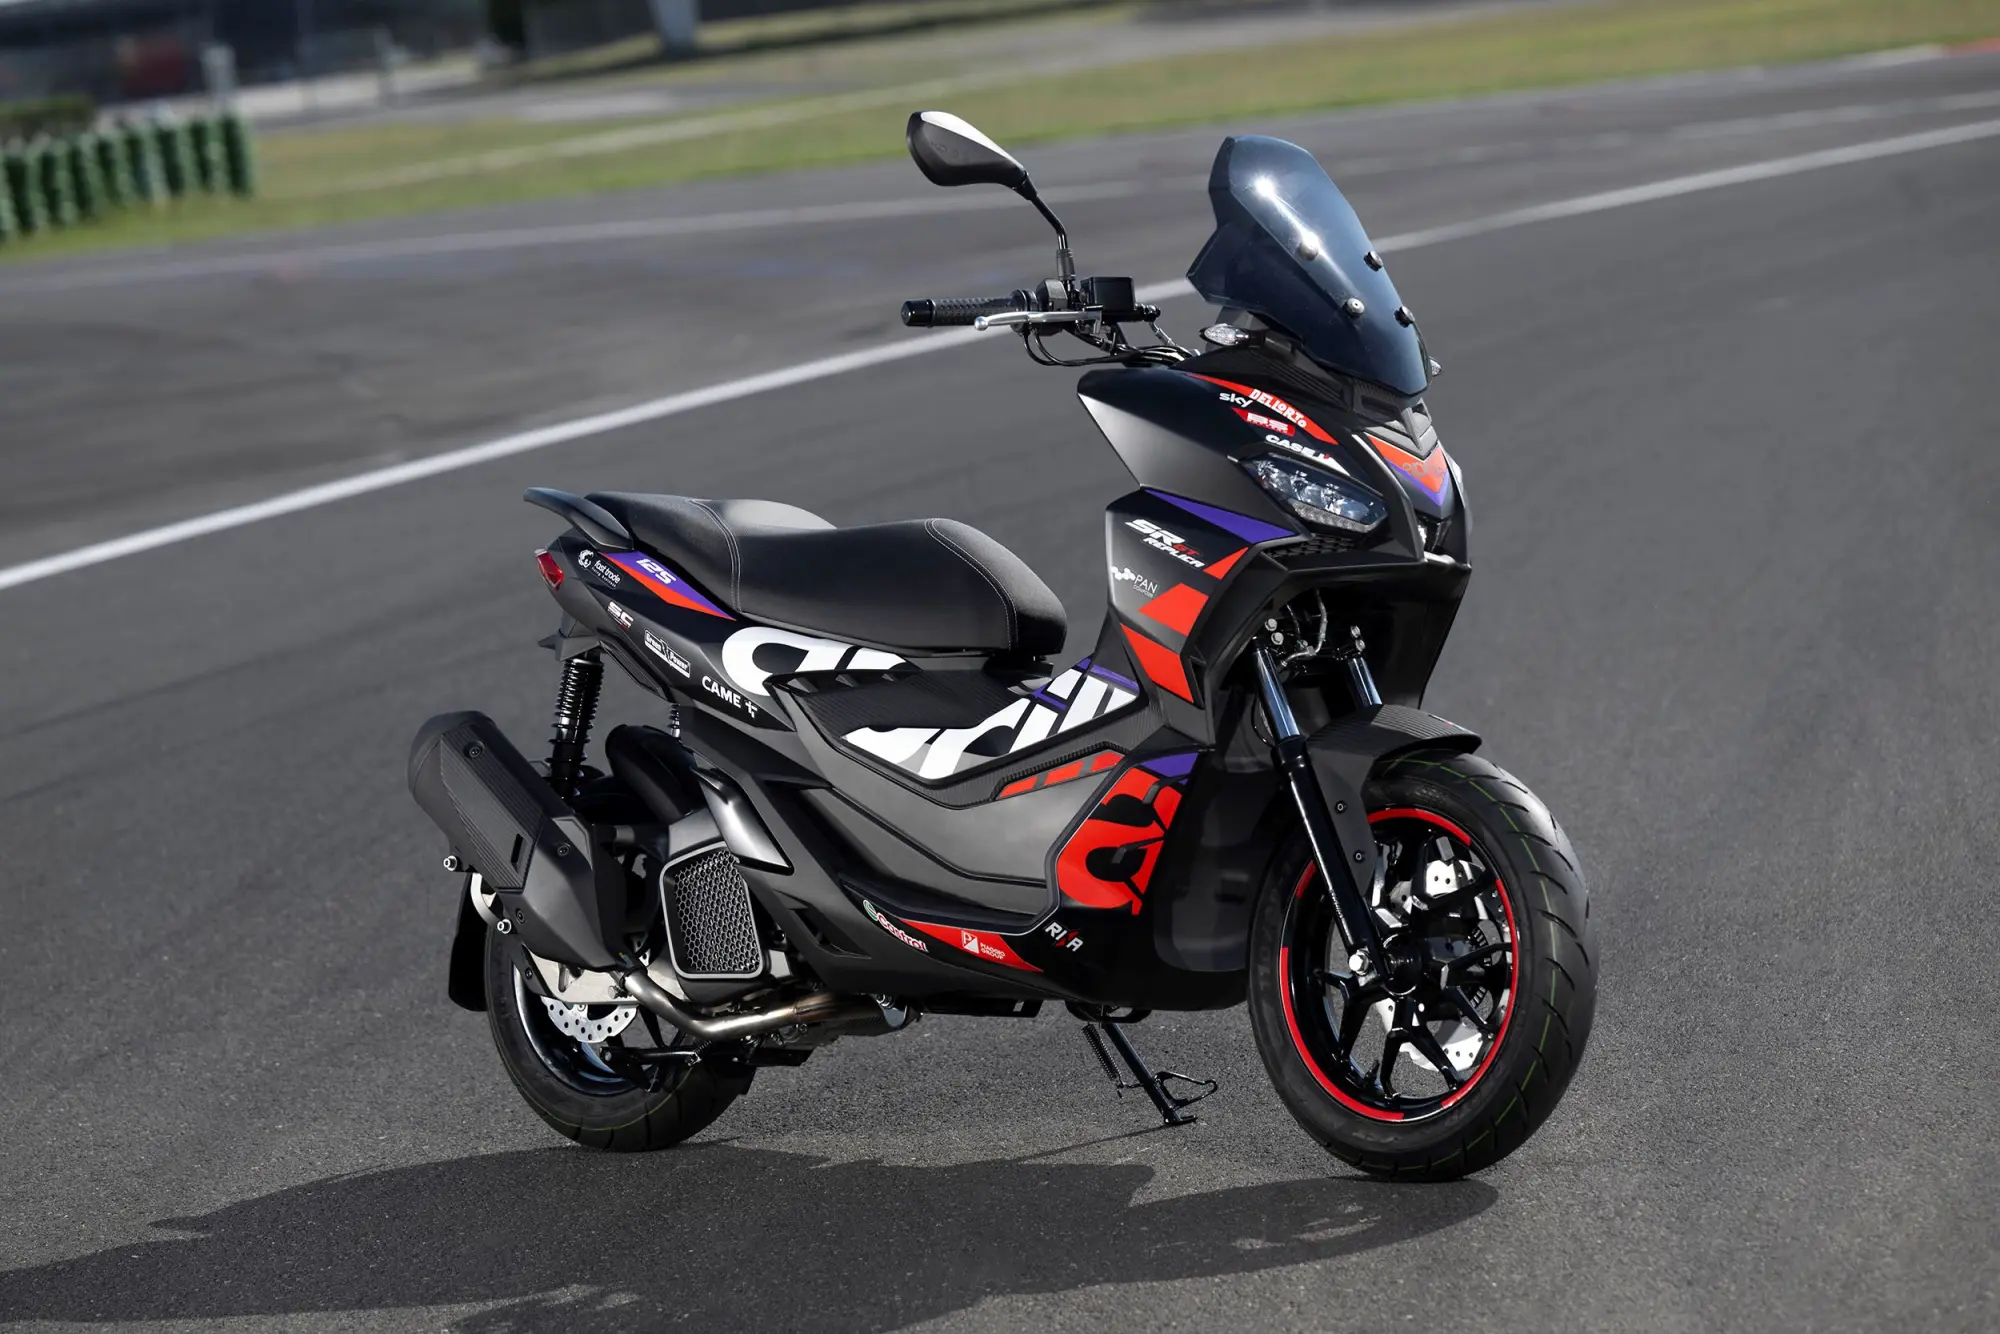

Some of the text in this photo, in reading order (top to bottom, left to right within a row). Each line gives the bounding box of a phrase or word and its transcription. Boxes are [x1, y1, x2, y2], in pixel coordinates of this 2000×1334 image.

[1219, 392, 1253, 408] sky
[1124, 518, 1186, 546] SR
[1142, 537, 1206, 568] REPLICA
[594, 559, 606, 573] fast
[604, 567, 621, 584] trade
[636, 558, 677, 584] 125
[1134, 574, 1158, 593] PAN
[701, 675, 742, 709] CAME
[877, 912, 929, 953] Castrol
